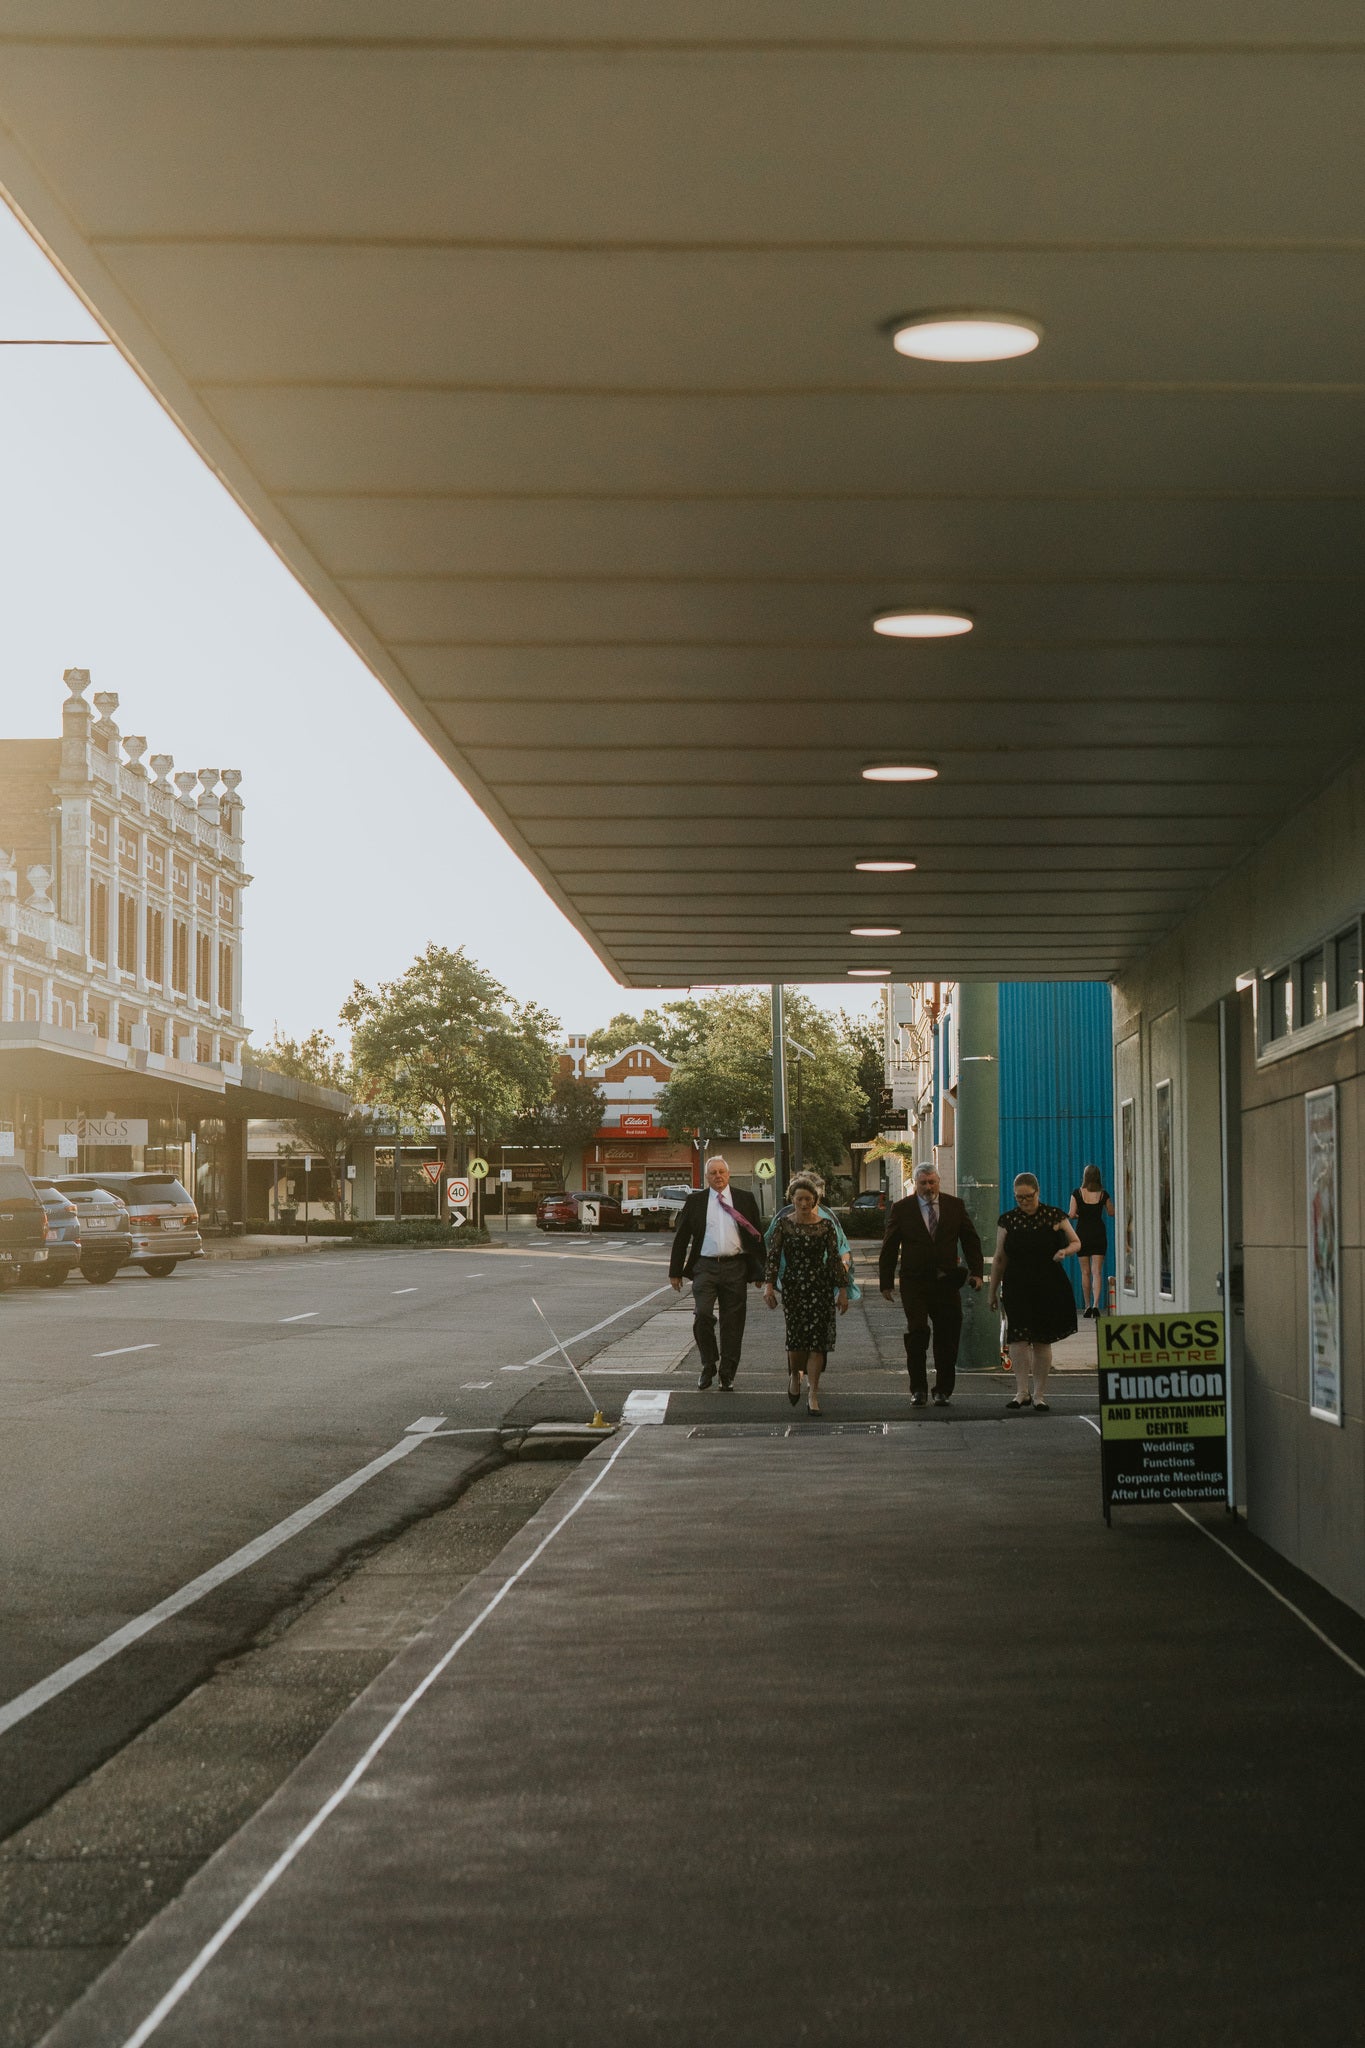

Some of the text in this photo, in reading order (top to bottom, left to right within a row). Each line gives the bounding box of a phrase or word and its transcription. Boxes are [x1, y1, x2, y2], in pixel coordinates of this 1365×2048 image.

[624, 1117, 649, 1125] Elders
[605, 1148, 634, 1159] Elders
[451, 1187, 466, 1197] 40
[1105, 1320, 1219, 1351] KINGS
[1107, 1350, 1217, 1364] THEATRE
[1107, 1370, 1224, 1400] Function
[1108, 1404, 1226, 1421] AND ENTERTAINMENT
[1146, 1422, 1189, 1436] CENTRE
[1142, 1441, 1195, 1453] Weddings
[1143, 1457, 1196, 1468] Functions
[1117, 1471, 1223, 1485] Corporate Meetings
[1111, 1486, 1226, 1500] After Life Celebration
